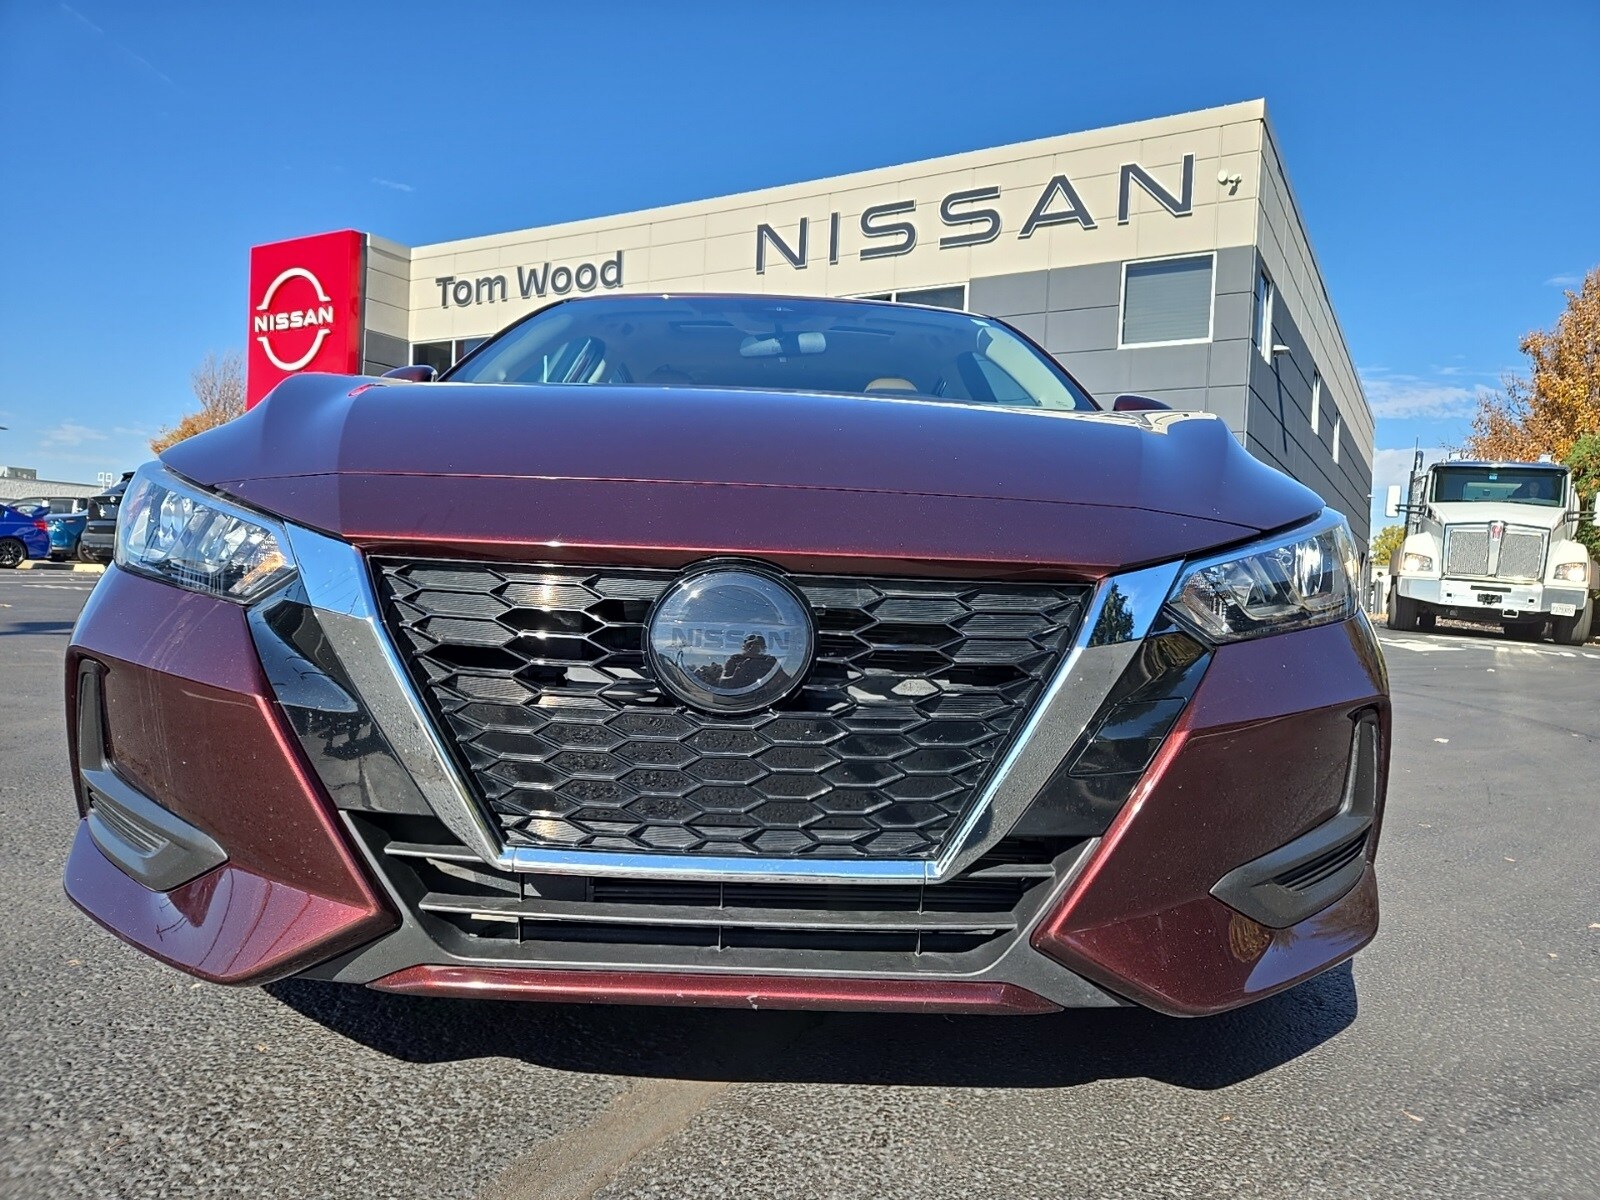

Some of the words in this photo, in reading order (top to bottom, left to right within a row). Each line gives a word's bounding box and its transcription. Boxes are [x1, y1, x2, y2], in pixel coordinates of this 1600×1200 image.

[755, 153, 1196, 274] NISSAN
[435, 275, 508, 309] Tom
[517, 250, 624, 299] Wood
[254, 305, 335, 333] NISSAN
